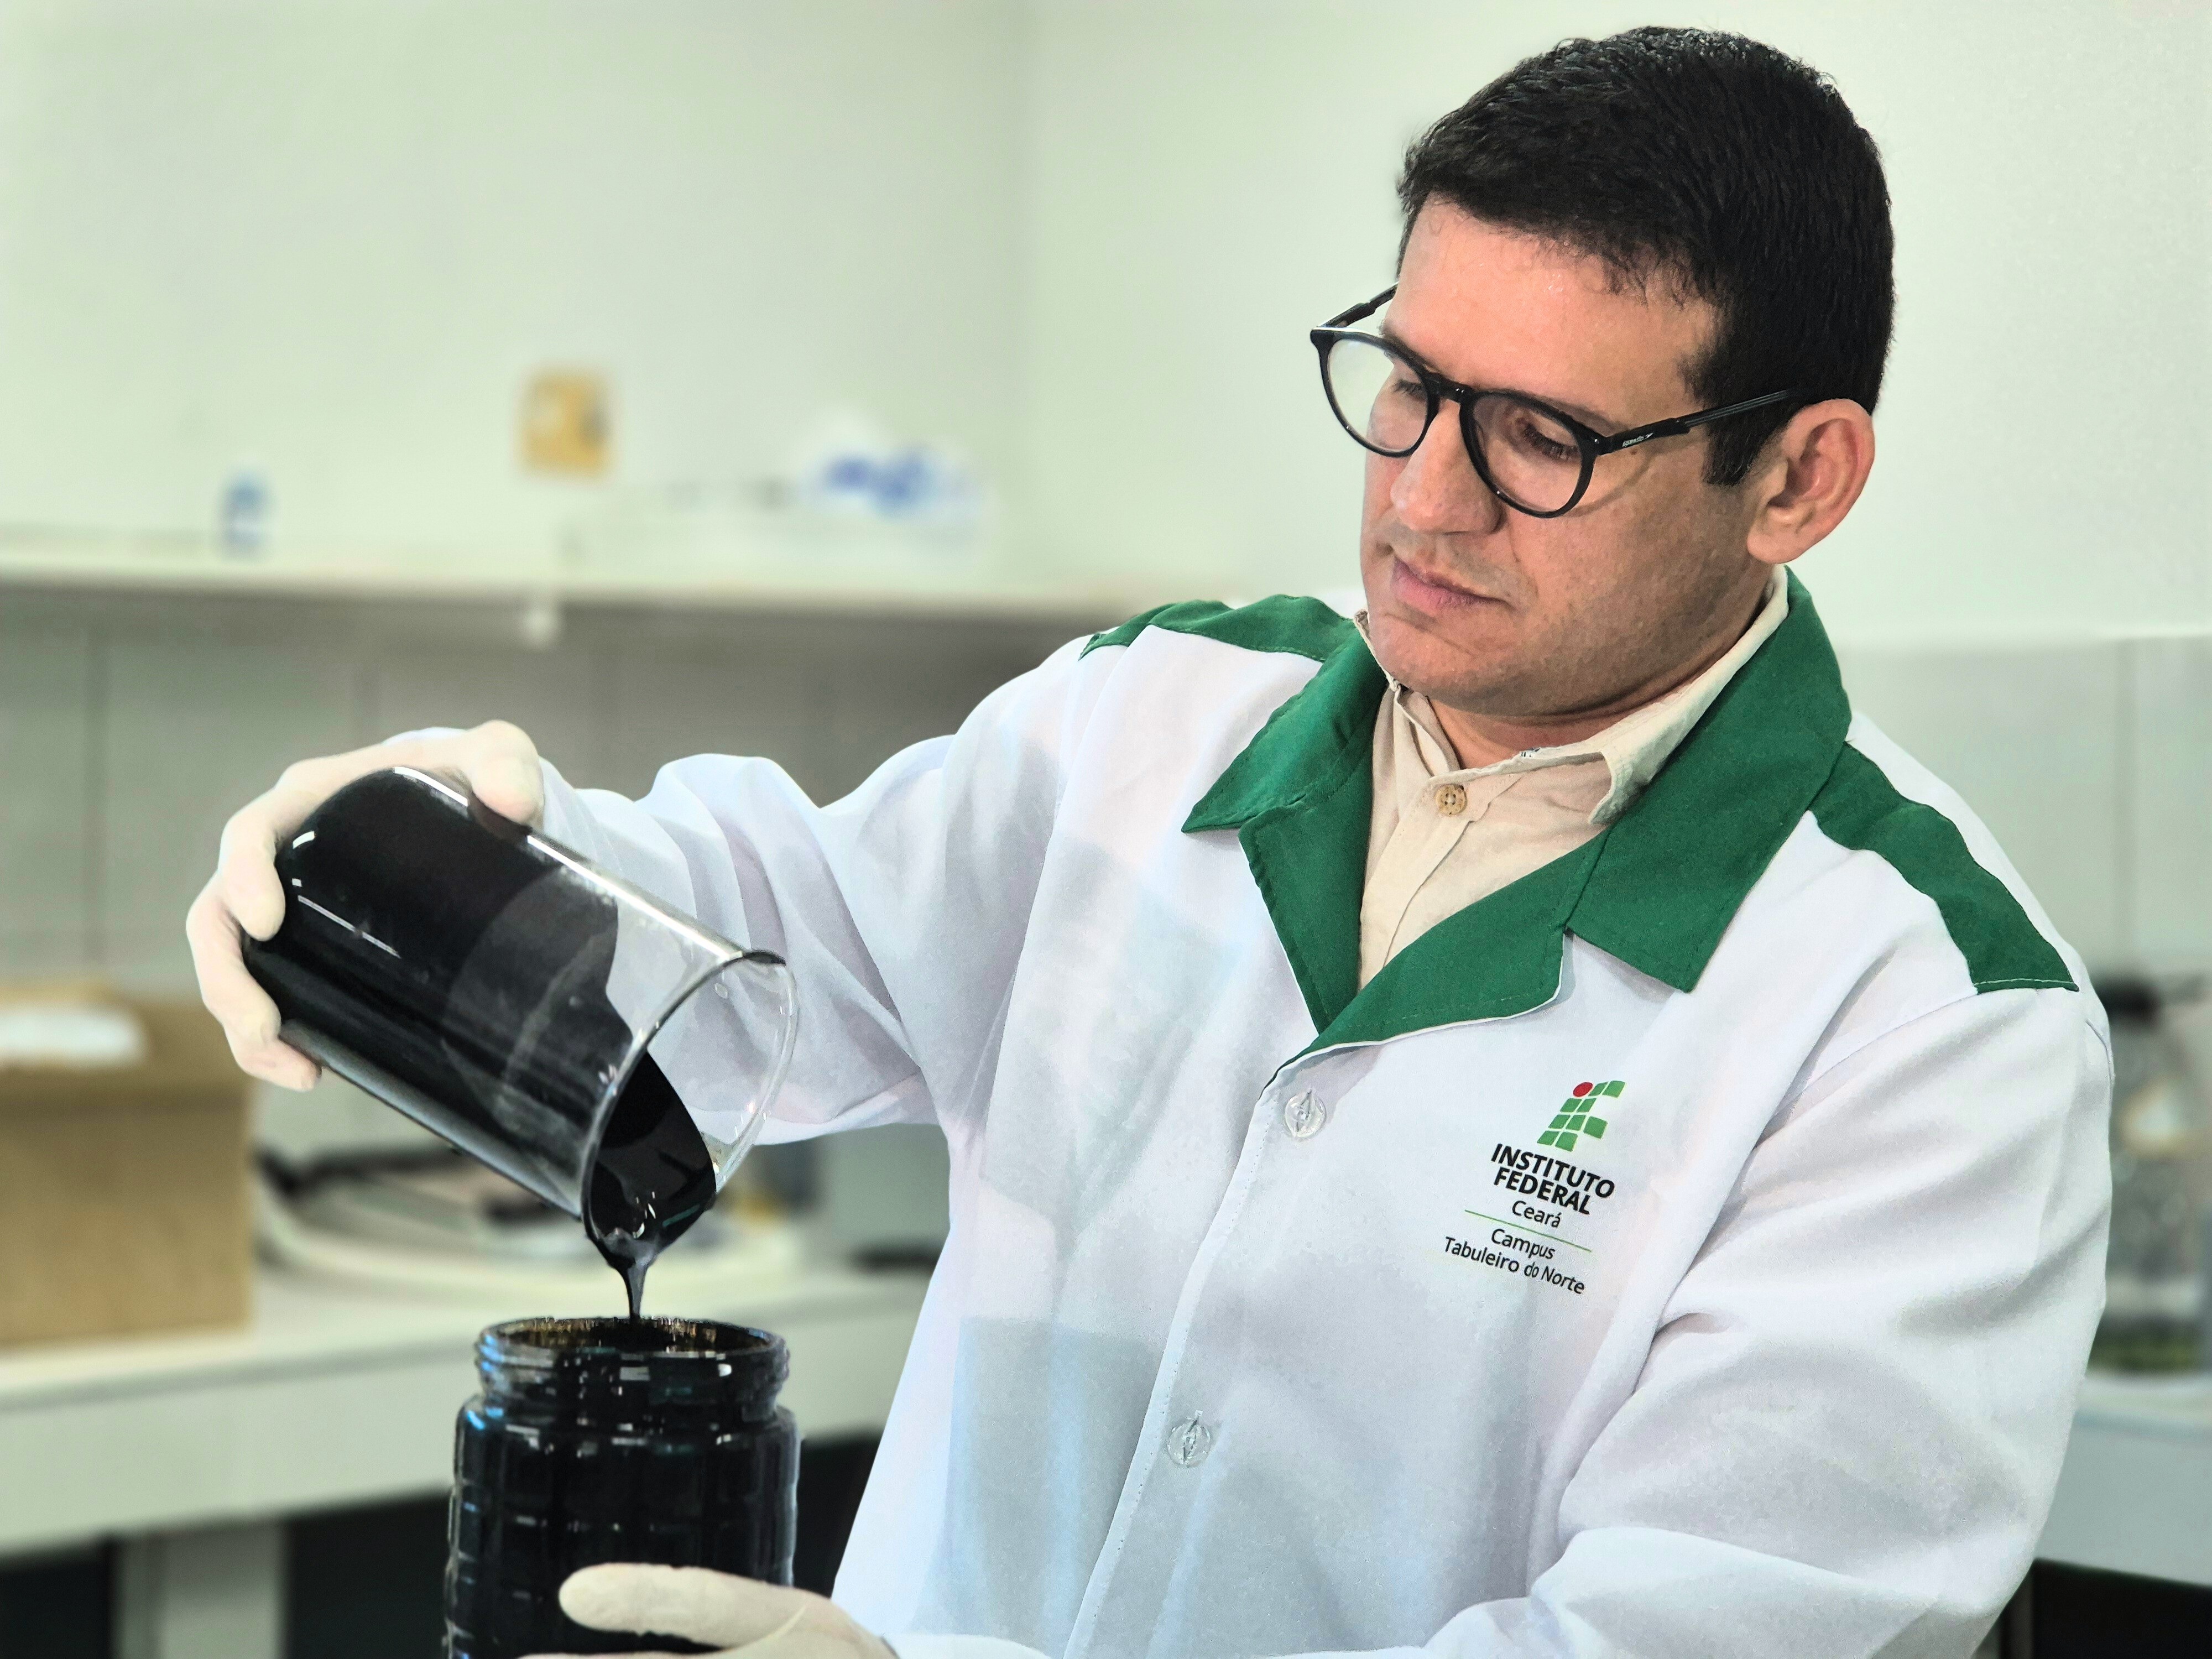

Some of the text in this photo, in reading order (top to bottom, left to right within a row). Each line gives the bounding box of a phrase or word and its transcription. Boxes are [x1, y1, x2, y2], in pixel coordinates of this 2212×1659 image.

[1491, 1143, 1615, 1198] INSTITUTO
[1493, 1167, 1590, 1215] FEDERAL
[1512, 1200, 1561, 1228] Ceará
[1445, 1236, 1585, 1295] Tabuleiro do Norte
[1491, 1228, 1556, 1259] Campus
